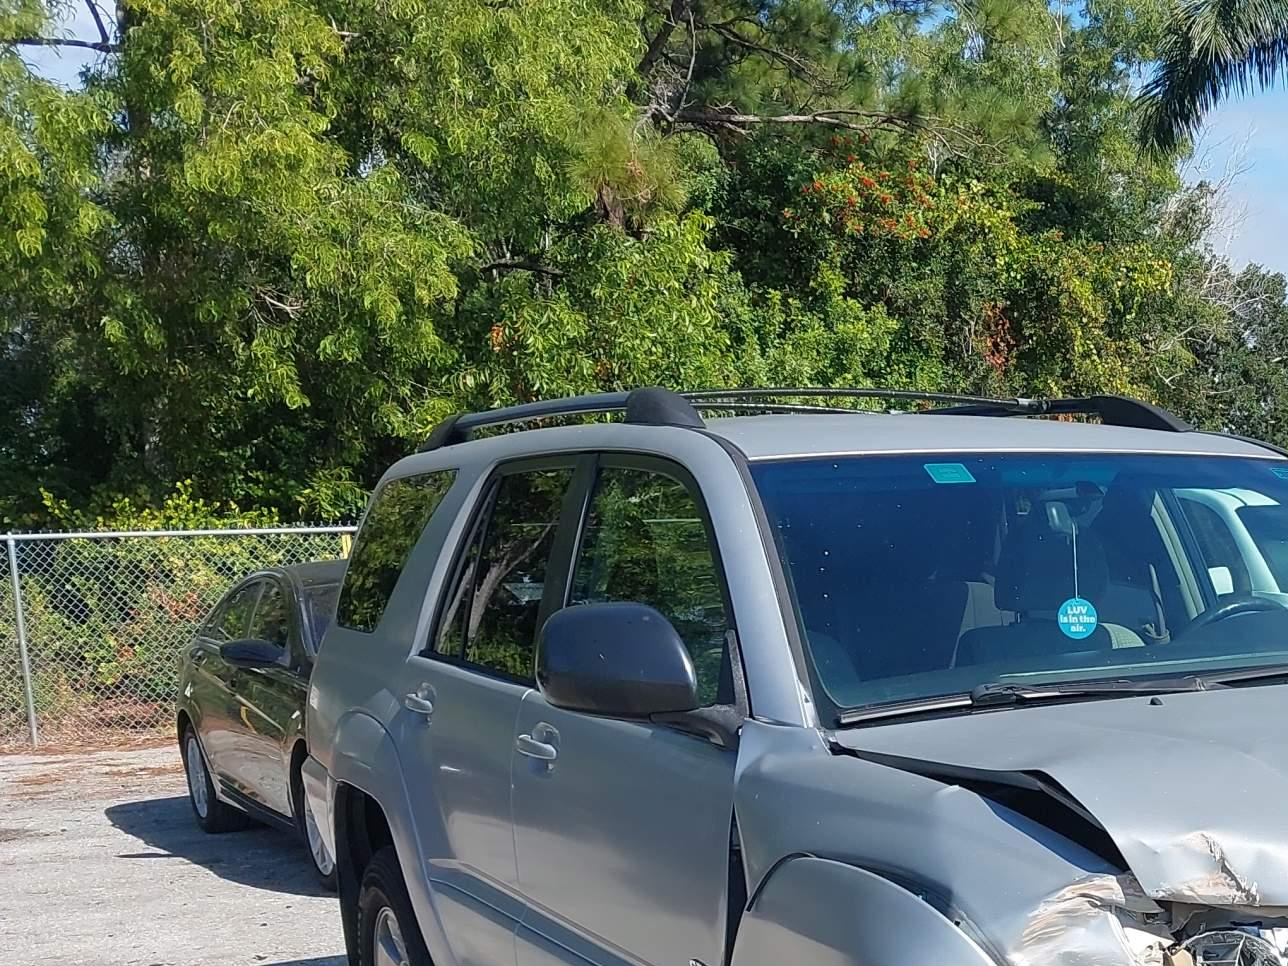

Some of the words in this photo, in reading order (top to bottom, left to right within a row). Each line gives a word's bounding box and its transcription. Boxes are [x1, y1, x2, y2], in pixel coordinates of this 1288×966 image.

[1067, 606, 1088, 614] LUV
[1069, 614, 1078, 623] in
[1079, 615, 1096, 623] the
